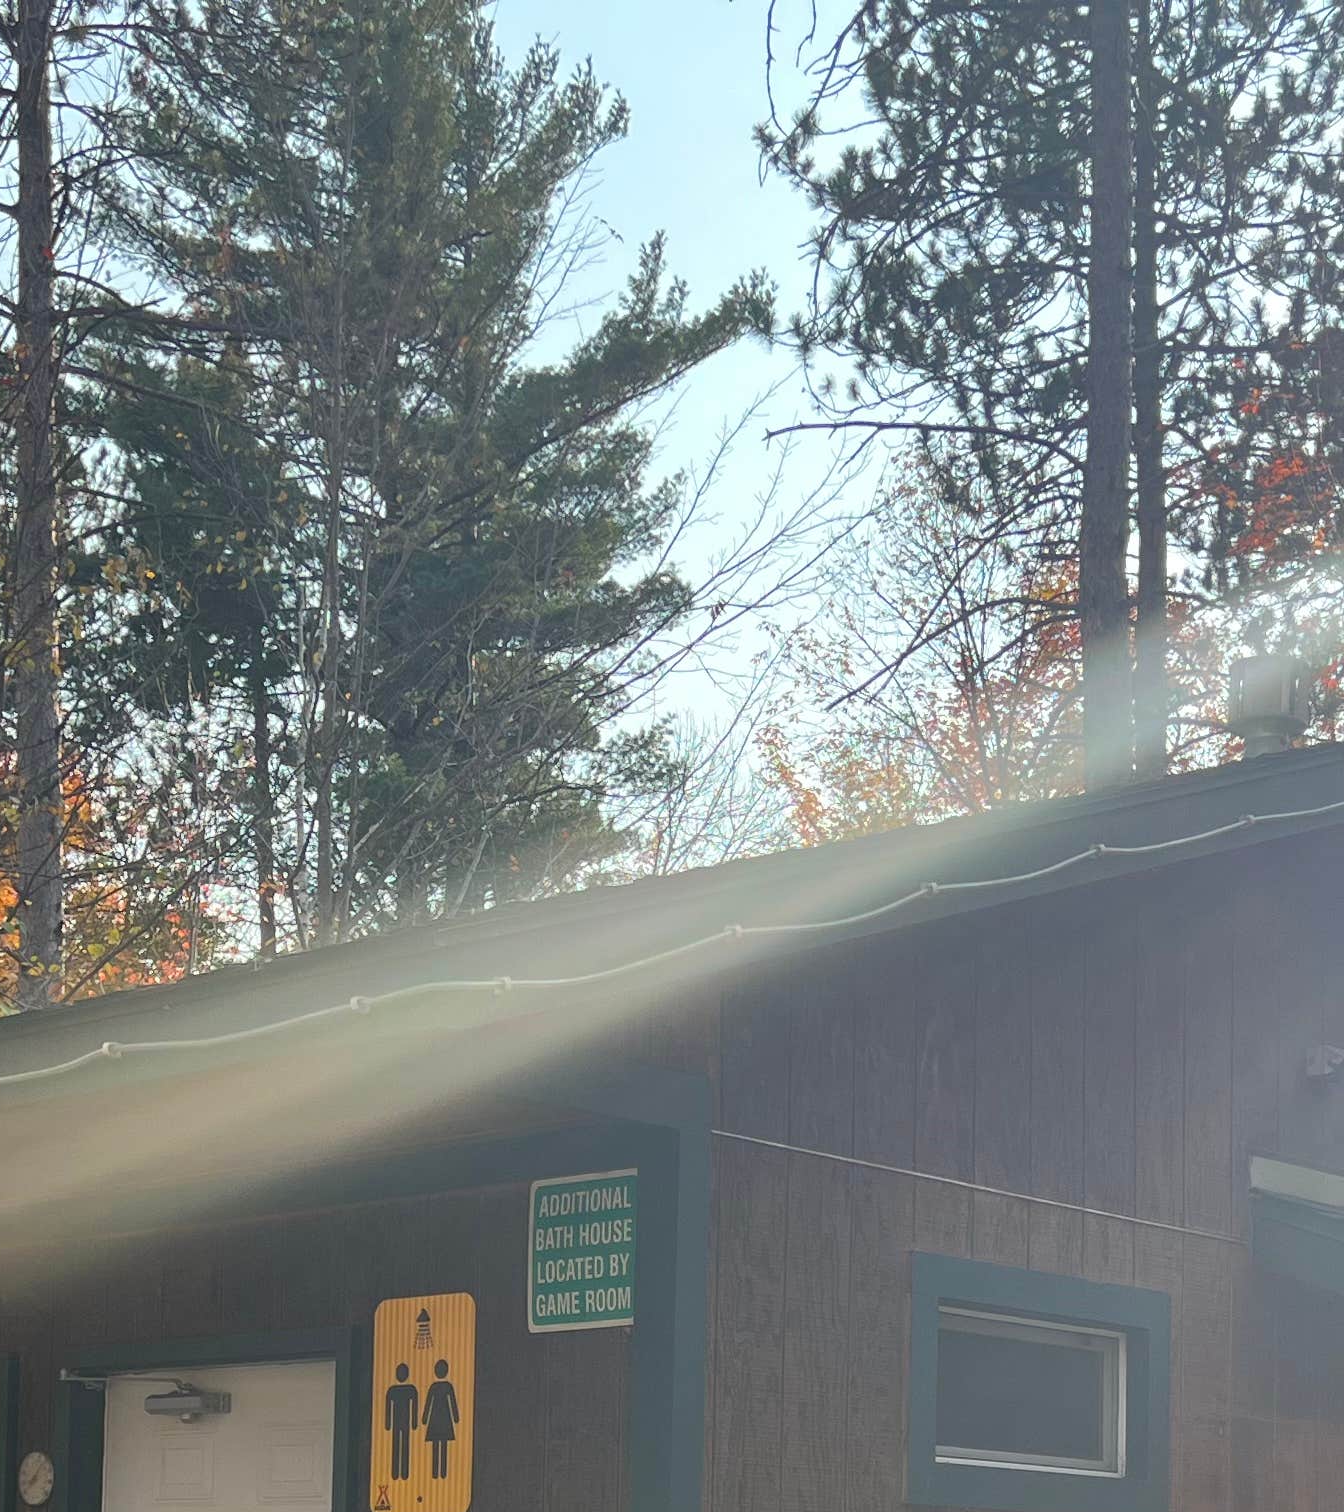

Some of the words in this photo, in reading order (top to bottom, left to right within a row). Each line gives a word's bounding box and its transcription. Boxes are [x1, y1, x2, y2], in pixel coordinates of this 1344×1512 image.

[539, 1186, 632, 1218] ADDITIONAL
[536, 1225, 574, 1251] BATH
[579, 1219, 633, 1247] HOUSE
[537, 1255, 604, 1284] LOCATED
[609, 1253, 630, 1277] BY
[536, 1291, 581, 1317] GAME
[585, 1286, 632, 1313] ROOM
